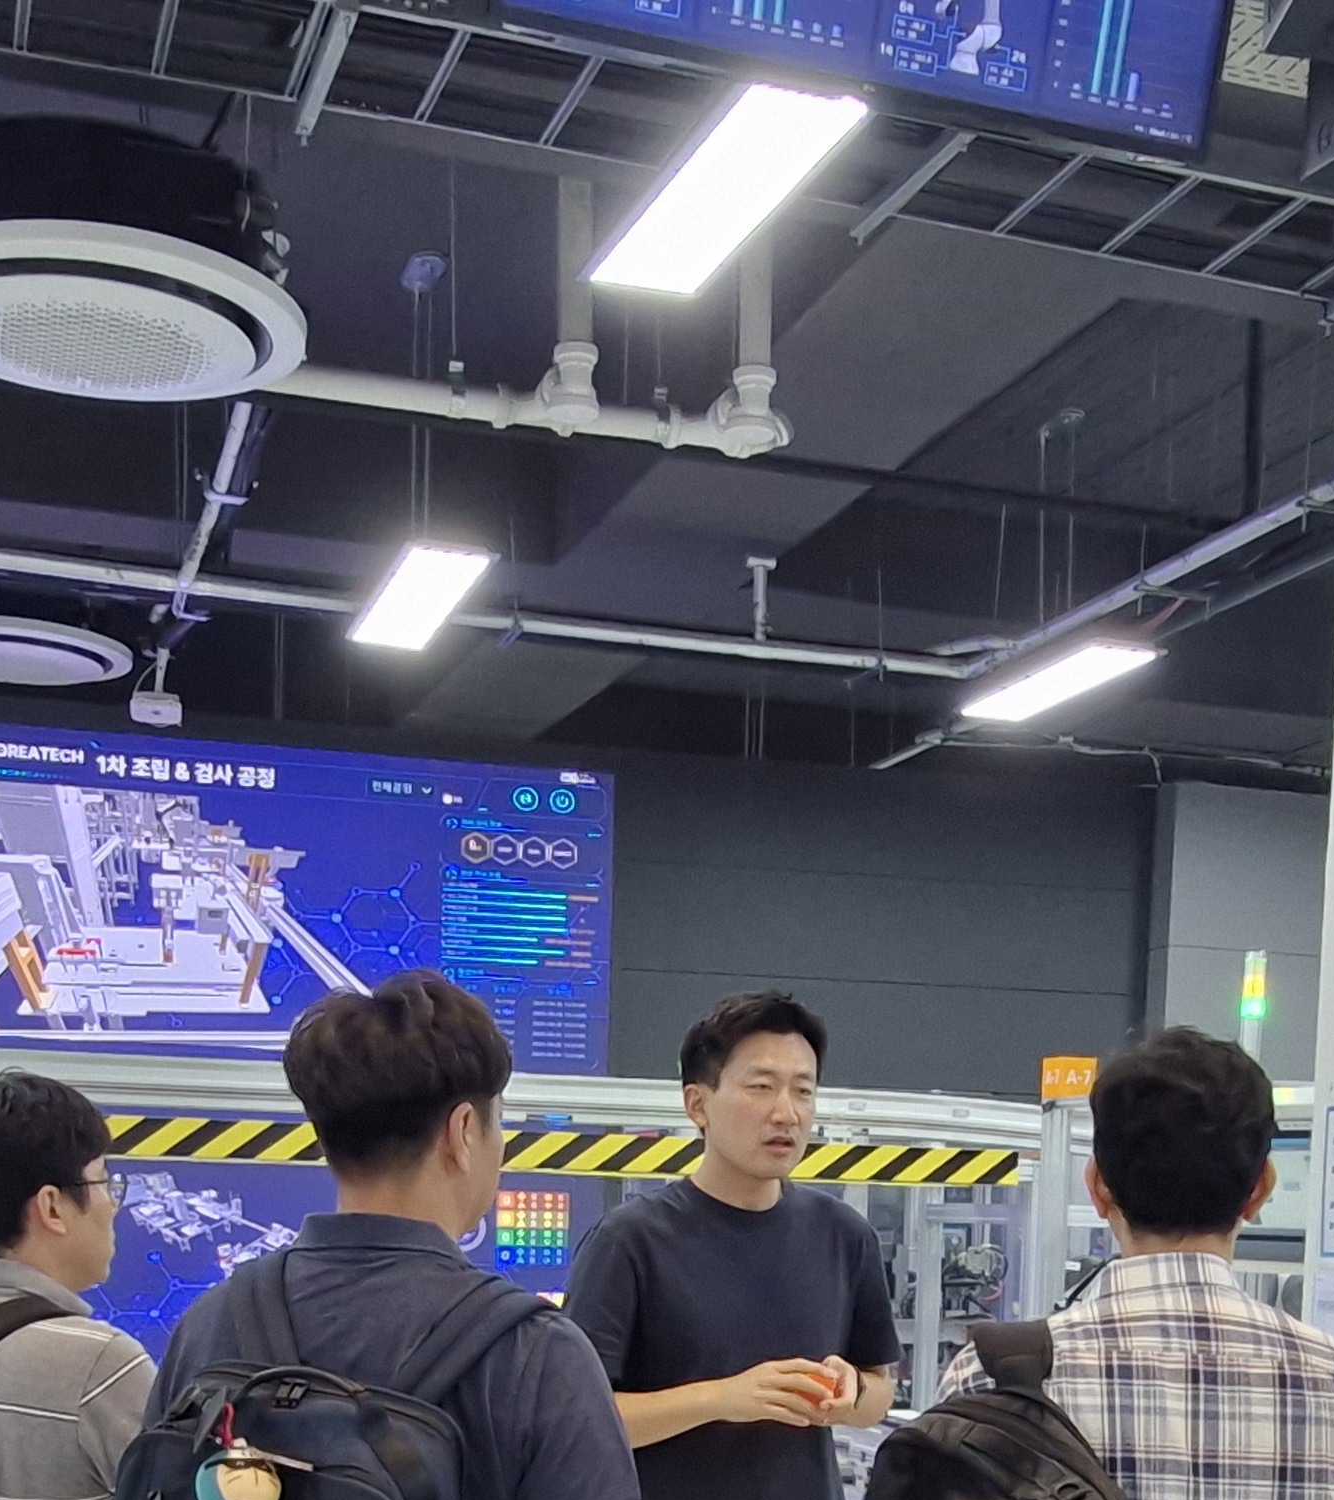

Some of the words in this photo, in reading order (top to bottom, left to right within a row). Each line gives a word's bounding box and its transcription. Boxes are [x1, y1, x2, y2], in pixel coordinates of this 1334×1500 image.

[96, 755, 127, 777] 1차
[131, 758, 170, 781] 조립
[175, 763, 189, 781] &
[194, 762, 233, 786] 검사
[238, 766, 276, 789] 공정
